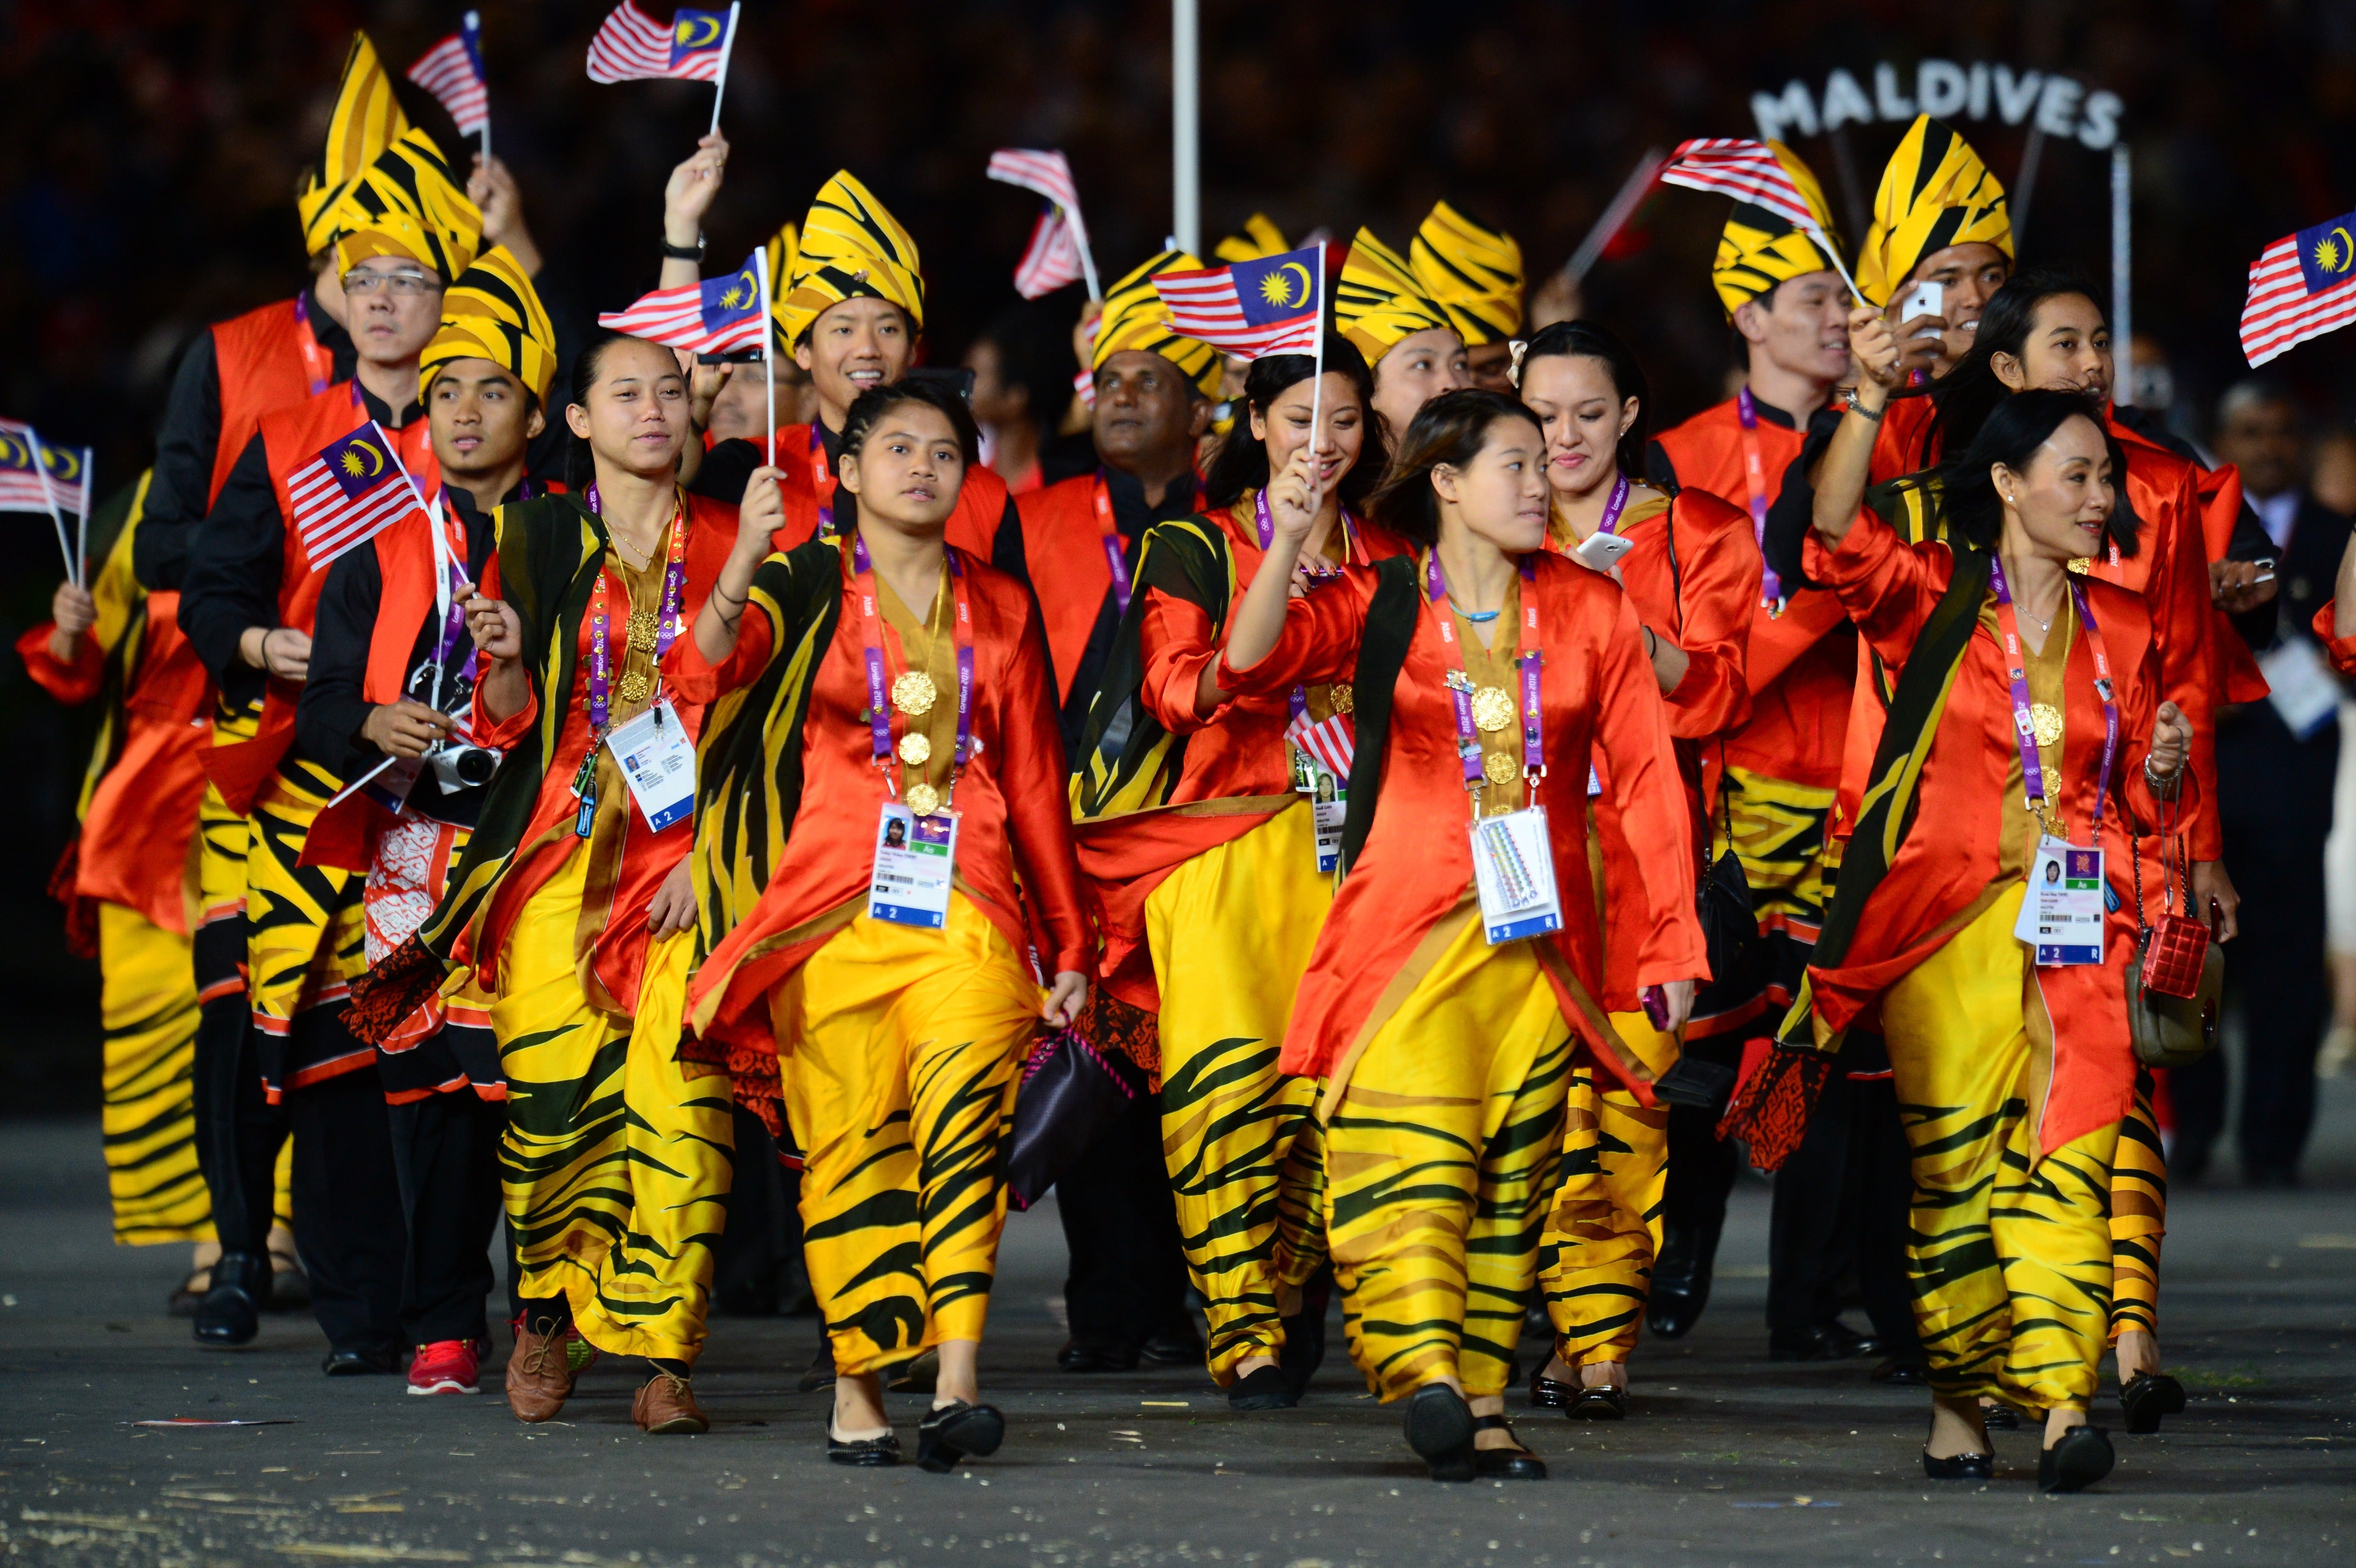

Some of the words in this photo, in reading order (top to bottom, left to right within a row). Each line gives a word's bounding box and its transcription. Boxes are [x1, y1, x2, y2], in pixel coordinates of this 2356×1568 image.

[1750, 58, 2124, 150] MALDIVES
[1611, 490, 1624, 511] London
[871, 661, 881, 689] London
[961, 666, 970, 685] 2012
[1528, 673, 1537, 690] 2012
[959, 686, 968, 714] London
[1457, 690, 1467, 715] ondon
[1529, 692, 1538, 711] ndon
[1461, 716, 1470, 733] 2012
[664, 811, 673, 822] 2
[874, 906, 881, 915] A
[889, 907, 897, 918] 2
[933, 914, 940, 925] R
[1492, 929, 1499, 938] A
[1503, 926, 1511, 937] 2
[1545, 916, 1553, 928] R
[2053, 947, 2060, 958] 2
[2091, 948, 2098, 959] R
